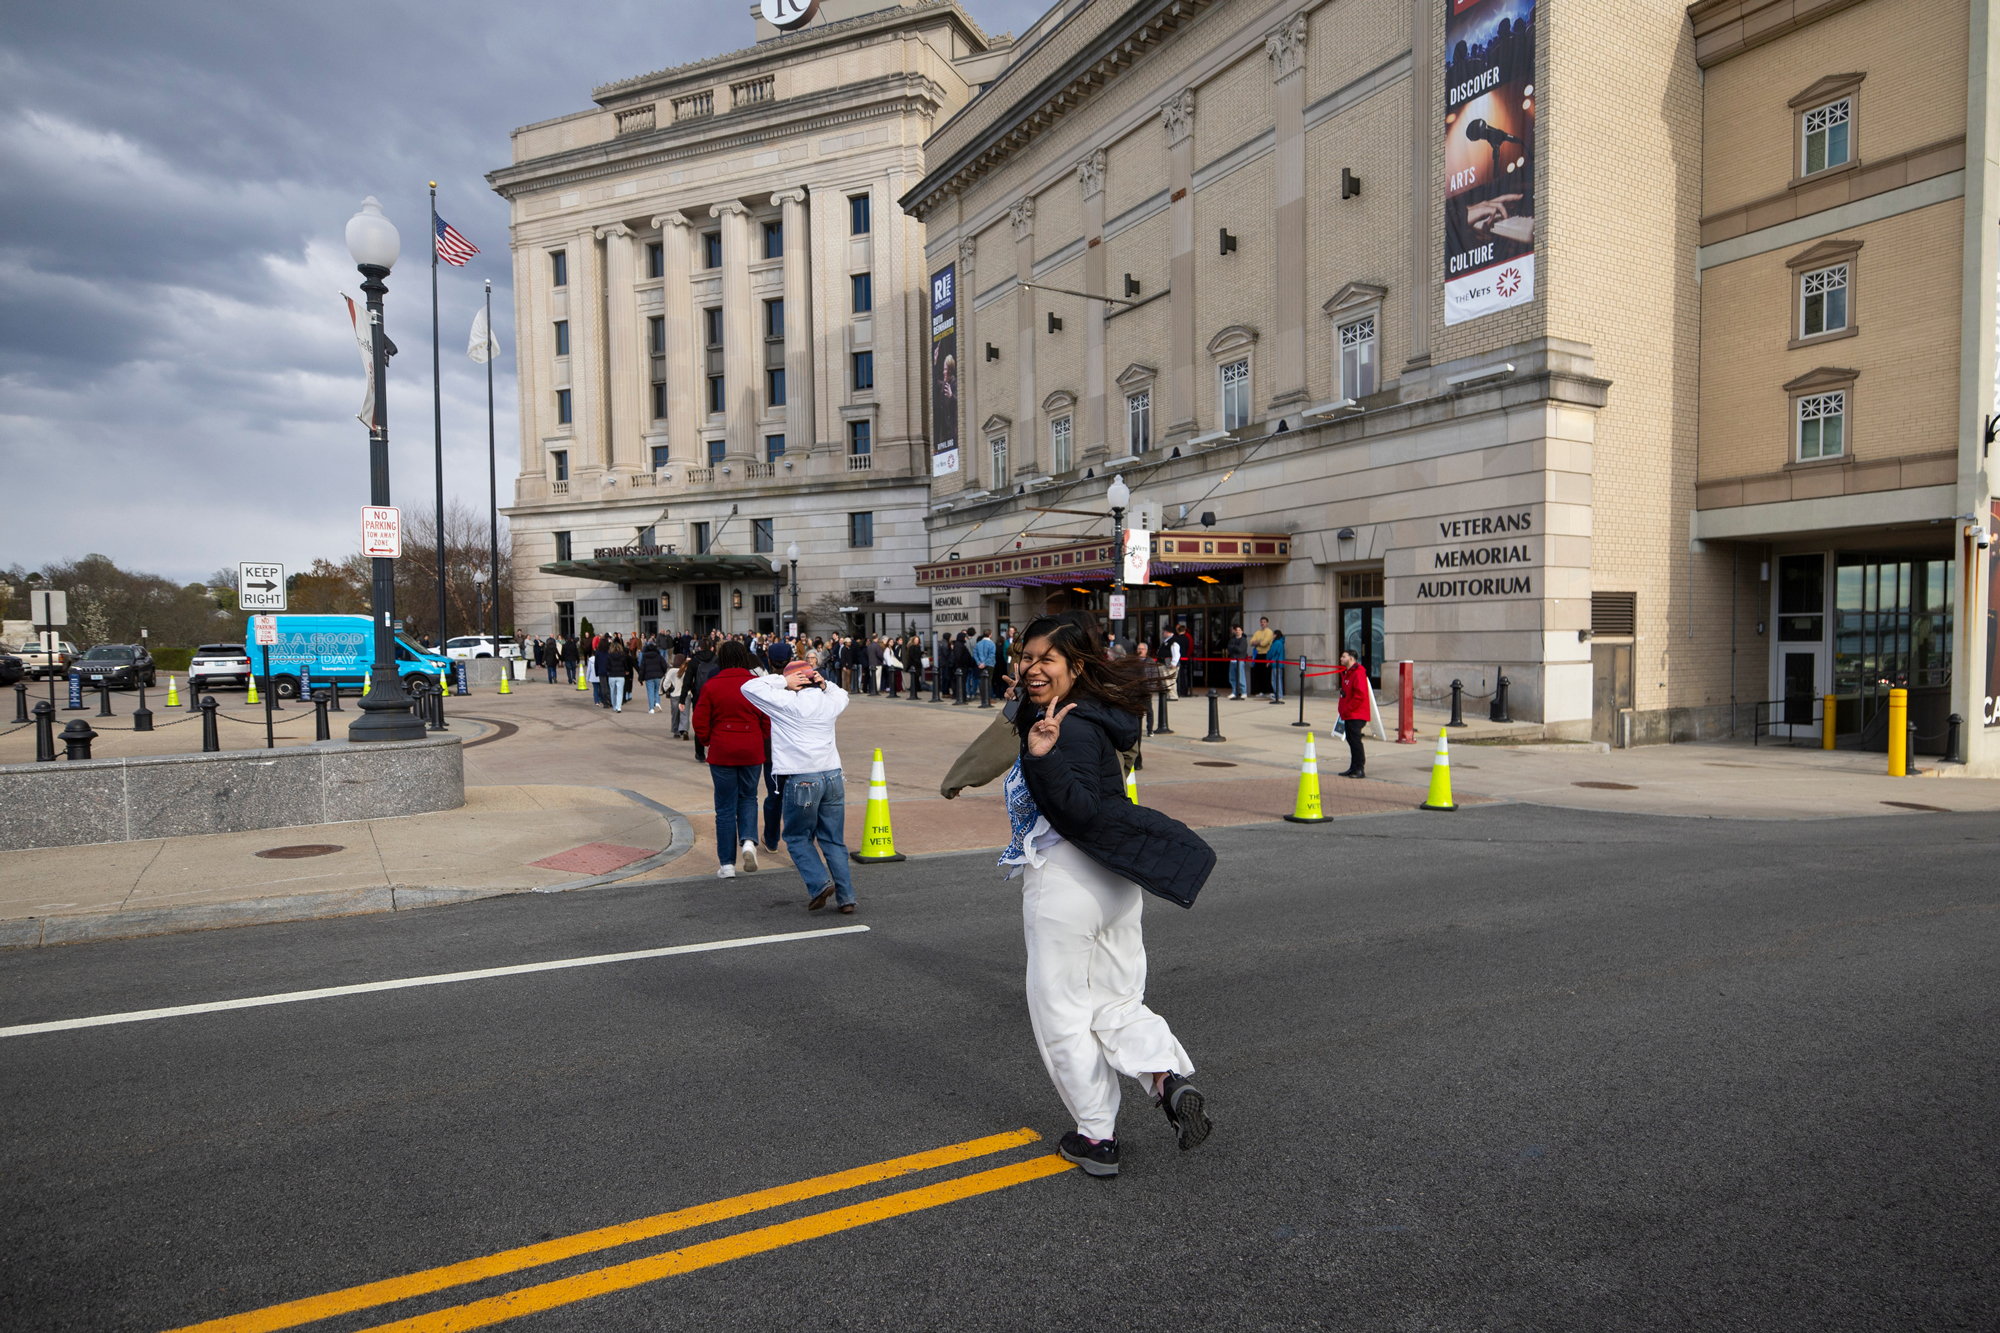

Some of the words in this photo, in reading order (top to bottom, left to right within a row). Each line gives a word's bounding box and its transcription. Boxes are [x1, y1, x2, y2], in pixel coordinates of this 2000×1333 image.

[1450, 66, 1500, 106] DISCOVER
[1450, 166, 1476, 193] ARTS
[1450, 242, 1494, 274] CULTURE
[374, 511, 388, 520] NO
[365, 520, 396, 531] PARKING
[1440, 512, 1531, 538] VETERANS
[374, 539, 389, 547] ZONE
[593, 544, 677, 559] RENAISSANCE
[1434, 545, 1531, 569] MEMORIAL
[245, 567, 278, 578] KEEP
[1417, 576, 1531, 599] AUDITORIUM
[244, 593, 281, 604] RIGHT
[935, 596, 963, 607] MEMORIAL
[935, 612, 969, 623] AUDITORIUM
[293, 633, 306, 644] A
[310, 633, 364, 644] GOOD
[268, 643, 300, 655] DAY
[304, 643, 339, 655] FOR
[344, 643, 358, 655] A
[268, 653, 317, 665] GOOD
[320, 653, 357, 665] DAY
[872, 825, 889, 834] THE
[870, 837, 892, 846] VETS
